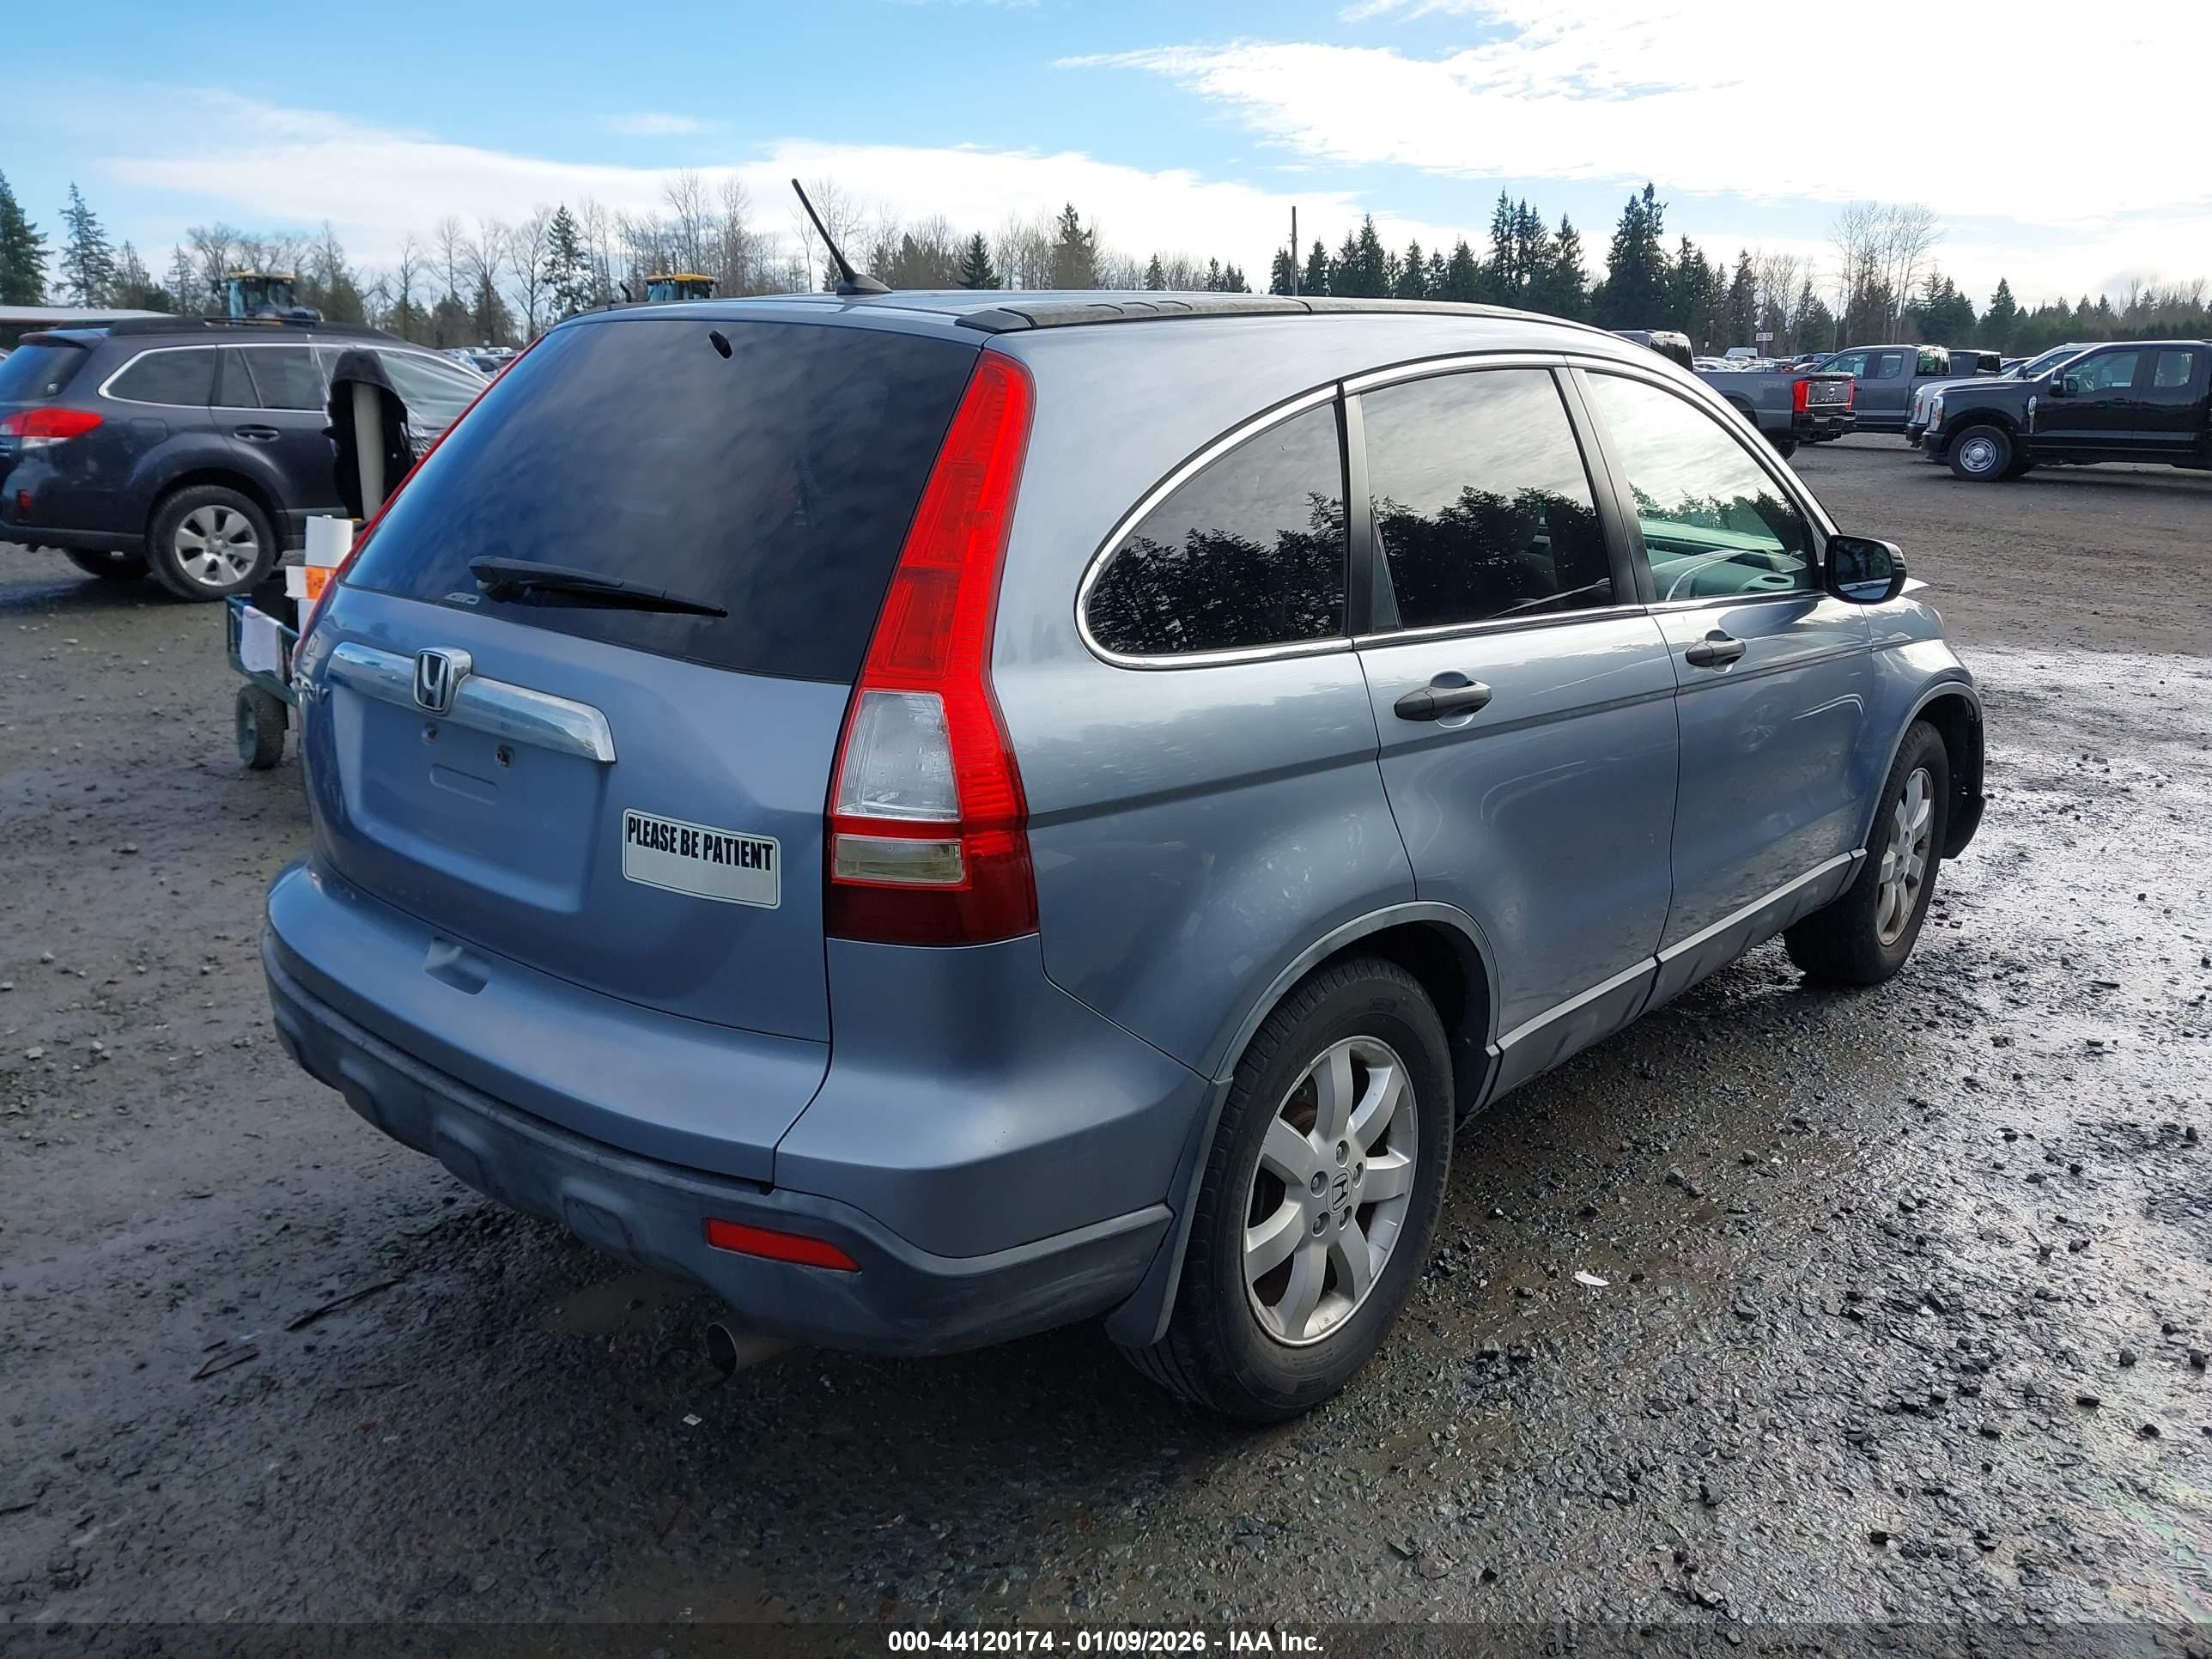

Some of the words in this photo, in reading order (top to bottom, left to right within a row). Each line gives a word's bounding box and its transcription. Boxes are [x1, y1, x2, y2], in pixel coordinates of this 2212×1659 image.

[628, 816, 677, 854] PLEASE
[680, 828, 699, 859] BE
[703, 833, 773, 871] PATIENT
